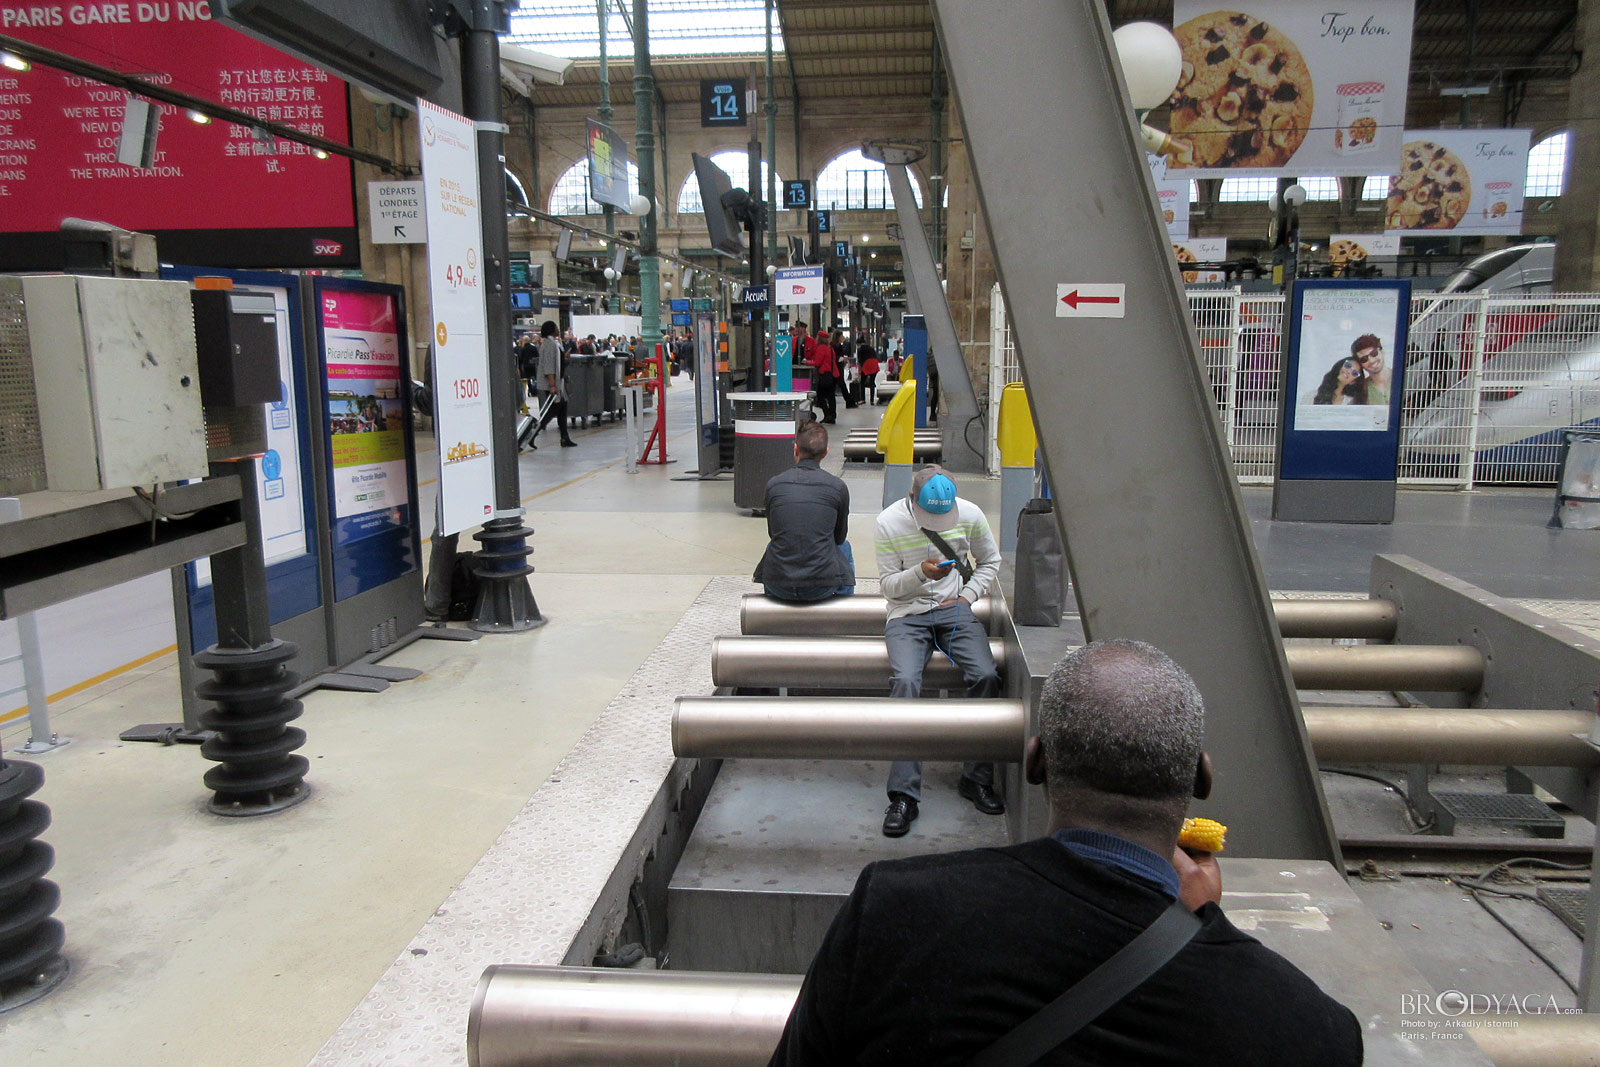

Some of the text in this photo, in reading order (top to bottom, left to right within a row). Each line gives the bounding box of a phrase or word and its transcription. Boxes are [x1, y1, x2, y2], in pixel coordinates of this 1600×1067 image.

[3, 7, 64, 28] PARIS
[69, 3, 131, 25] GARE
[138, 2, 170, 22] DU
[1321, 12, 1391, 43] Trop bon.
[219, 67, 328, 85] 为了让您在火车站
[88, 90, 121, 102] YOUR
[710, 95, 738, 116] 14
[81, 122, 109, 133] NEW
[1475, 142, 1496, 160] Trop
[70, 166, 184, 179] THE TRAIN STATION.
[379, 186, 417, 196] DÉPARTS
[789, 189, 806, 203] 13
[380, 199, 418, 207] LONDRES
[392, 209, 418, 219] ÉTAGE
[314, 245, 341, 254] SNCF
[446, 264, 463, 288] 4,9
[782, 270, 815, 278] INFORMATION
[745, 289, 768, 302] Accueil
[327, 347, 354, 360] Picardie
[453, 377, 480, 400] 1500
